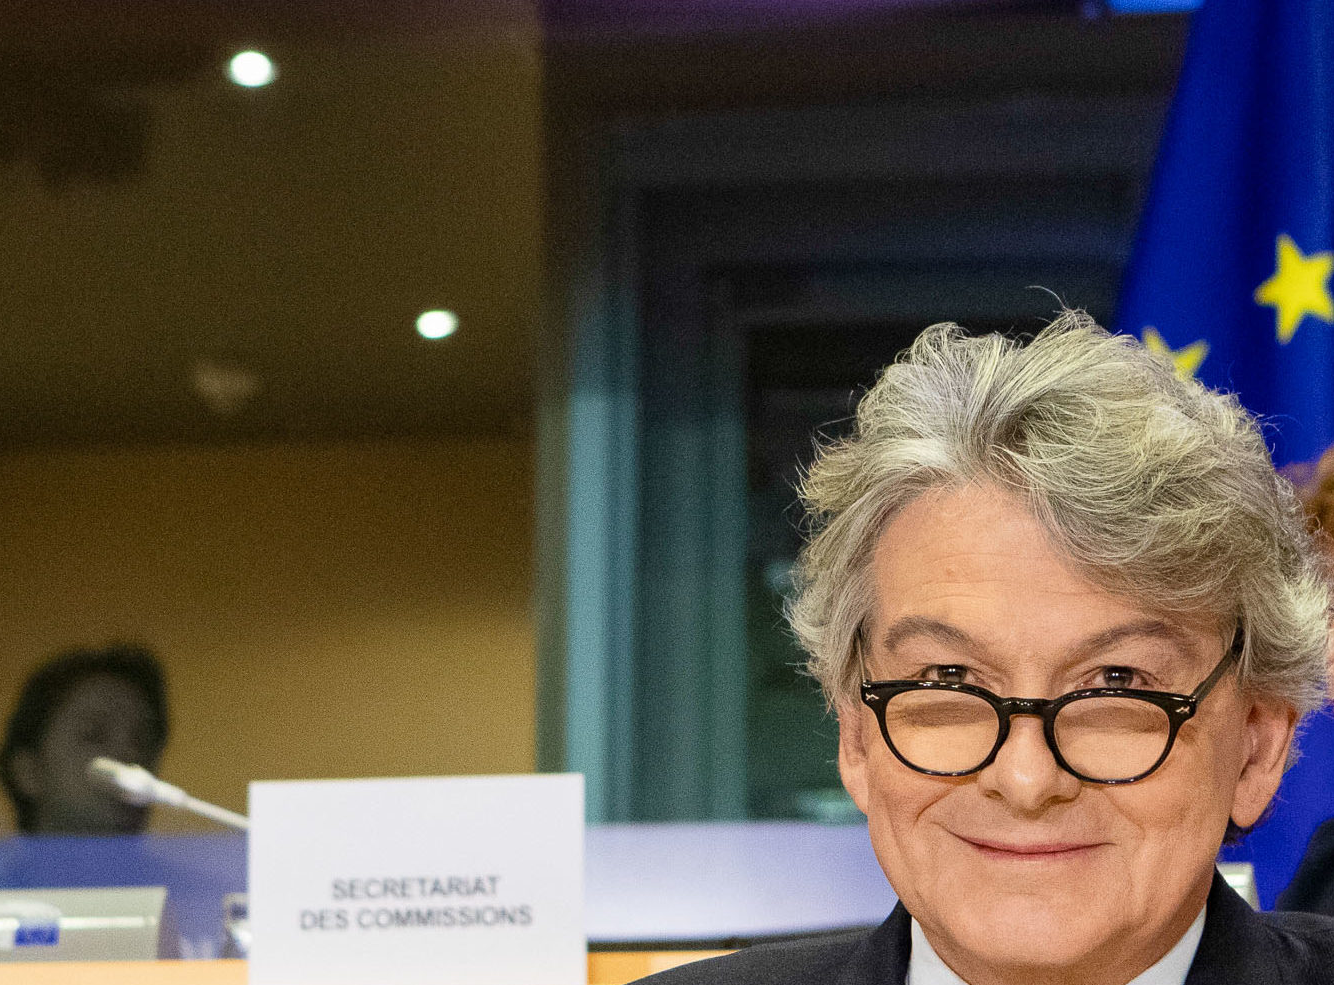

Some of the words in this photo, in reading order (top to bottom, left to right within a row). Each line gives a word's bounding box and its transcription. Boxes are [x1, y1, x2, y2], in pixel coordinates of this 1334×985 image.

[332, 876, 501, 900] SECRETARIAT
[300, 909, 349, 931] DES
[357, 905, 533, 929] COMMISSIONS
